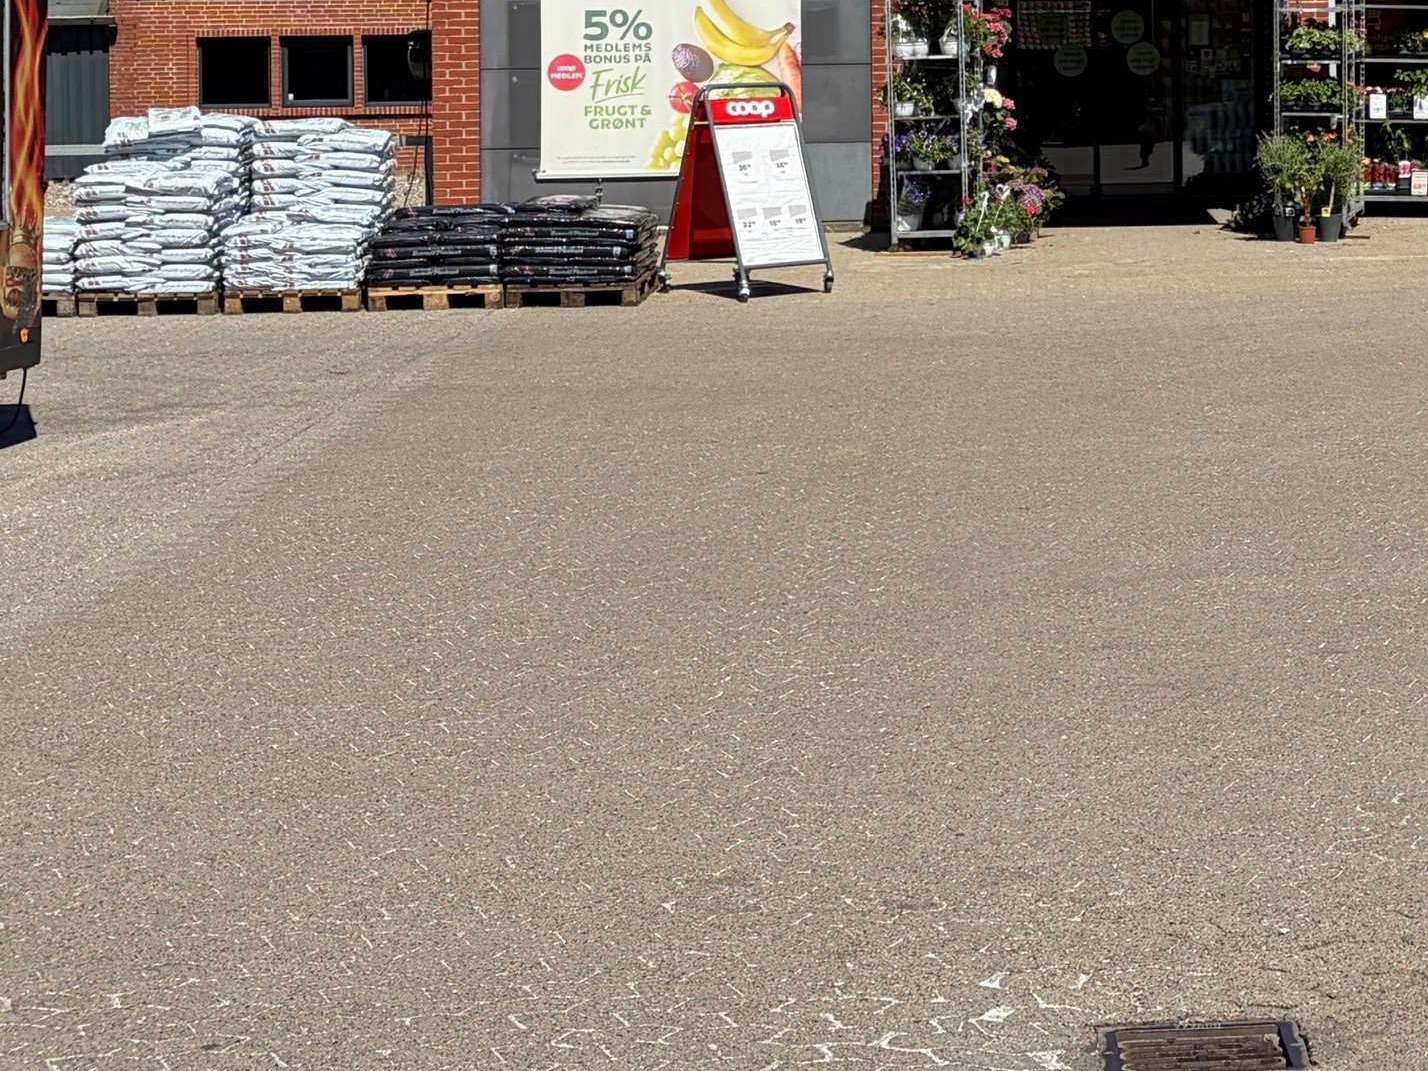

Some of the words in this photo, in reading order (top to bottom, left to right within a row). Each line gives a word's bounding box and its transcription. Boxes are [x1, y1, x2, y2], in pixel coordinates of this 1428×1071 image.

[583, 9, 653, 41] 5%
[584, 43, 652, 52] MEDLEMS
[584, 55, 630, 64] BONUS
[634, 52, 652, 64] PÅ
[589, 66, 647, 102] Frisk
[584, 105, 638, 116] FRUGT
[641, 104, 652, 116] &
[726, 101, 775, 118] coop
[589, 117, 646, 130] GRØNT
